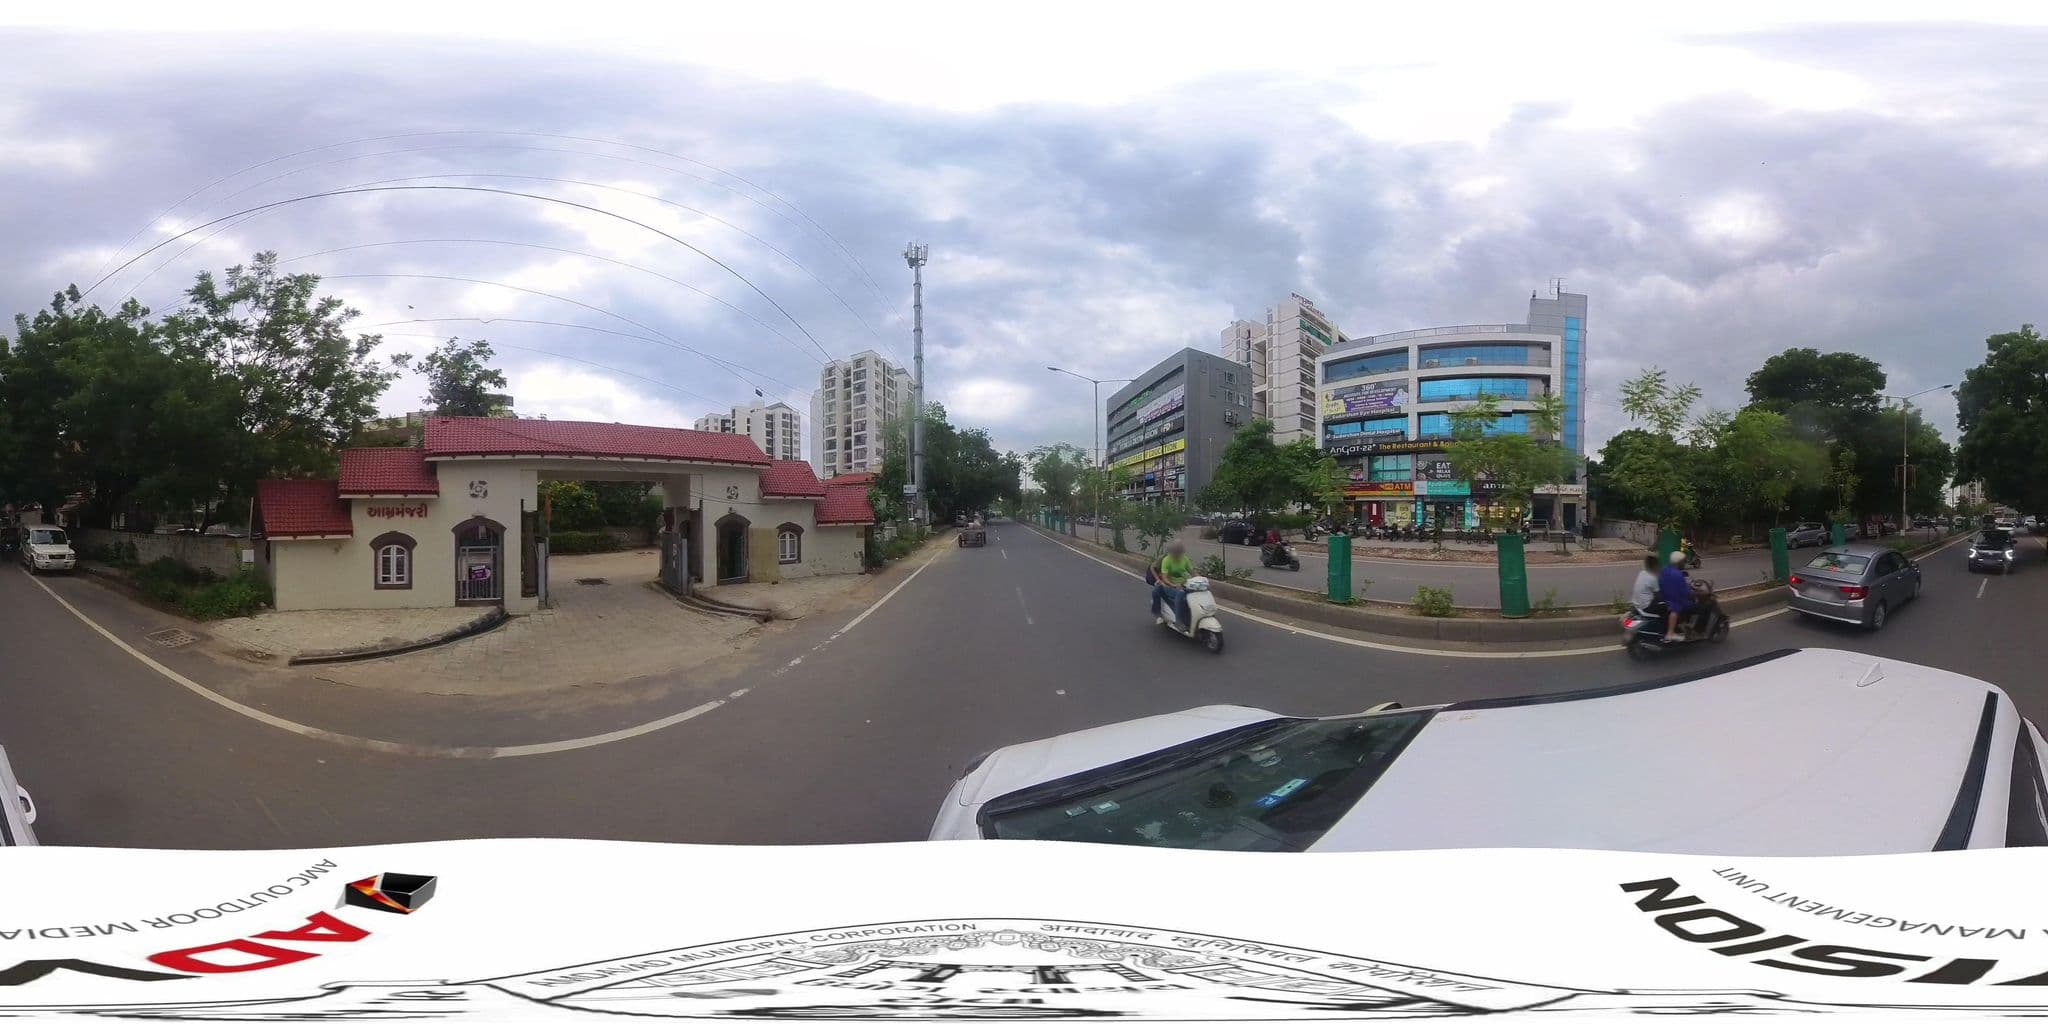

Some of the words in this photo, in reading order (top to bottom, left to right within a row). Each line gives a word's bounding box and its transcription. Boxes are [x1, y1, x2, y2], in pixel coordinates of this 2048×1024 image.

[1371, 408, 1395, 416] Hospital
[1376, 428, 1400, 436] Hospital
[1392, 441, 1431, 449] Restaurant
